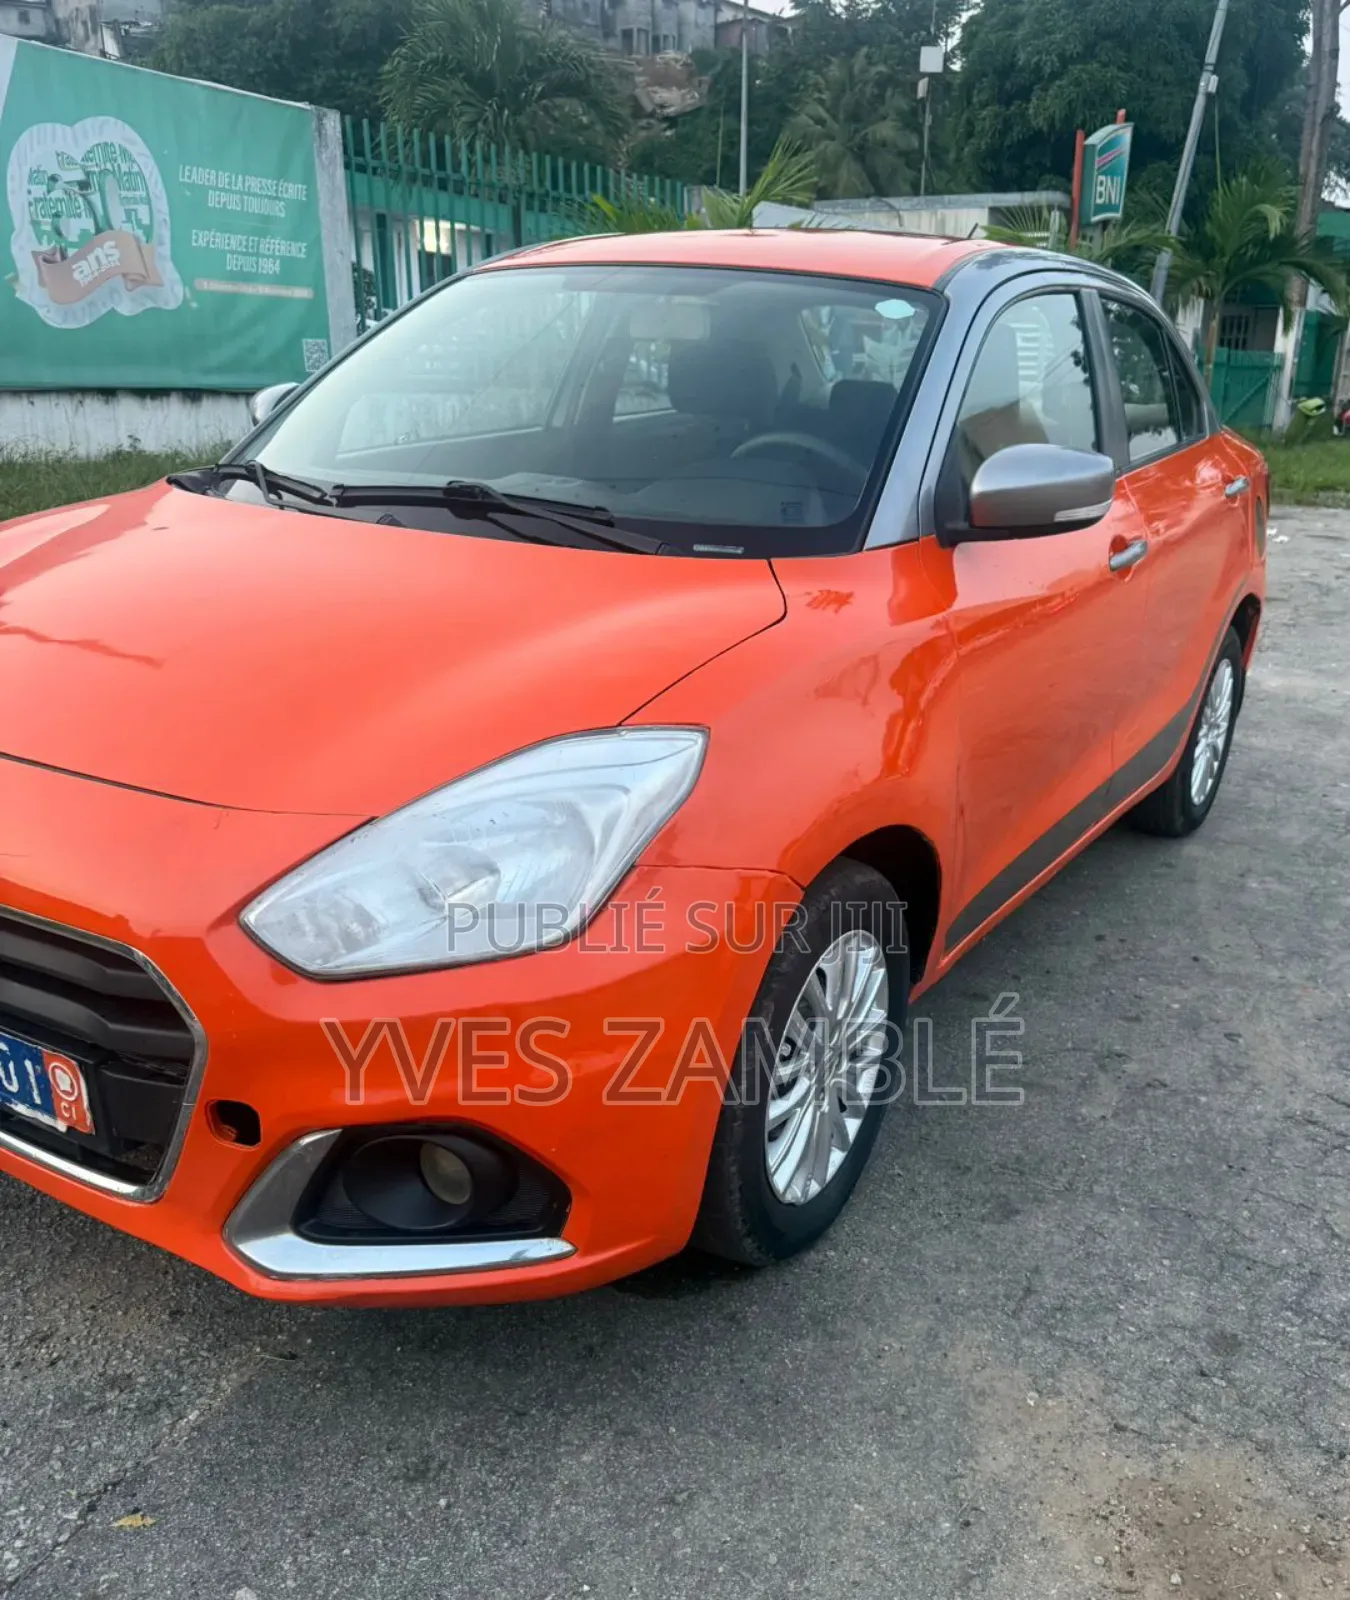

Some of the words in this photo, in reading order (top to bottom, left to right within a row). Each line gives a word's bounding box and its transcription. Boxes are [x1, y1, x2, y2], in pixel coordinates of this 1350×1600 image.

[179, 164, 217, 187] LEADER
[218, 171, 230, 189] DE
[231, 173, 243, 191] LA
[244, 175, 277, 197] PRESSE
[278, 178, 307, 201] ÉCRITE
[1095, 175, 1121, 204] BNI
[208, 189, 241, 211] DEPUIS
[243, 195, 286, 217] TOUJOURS
[191, 229, 248, 252] EXPÉRIENCE
[248, 236, 259, 253] ET
[259, 235, 307, 259] RÉFÉRENCE
[72, 240, 120, 283] ans
[226, 253, 257, 273] DEPUIS
[258, 257, 280, 275] 1964
[61, 1101, 77, 1121] CI
